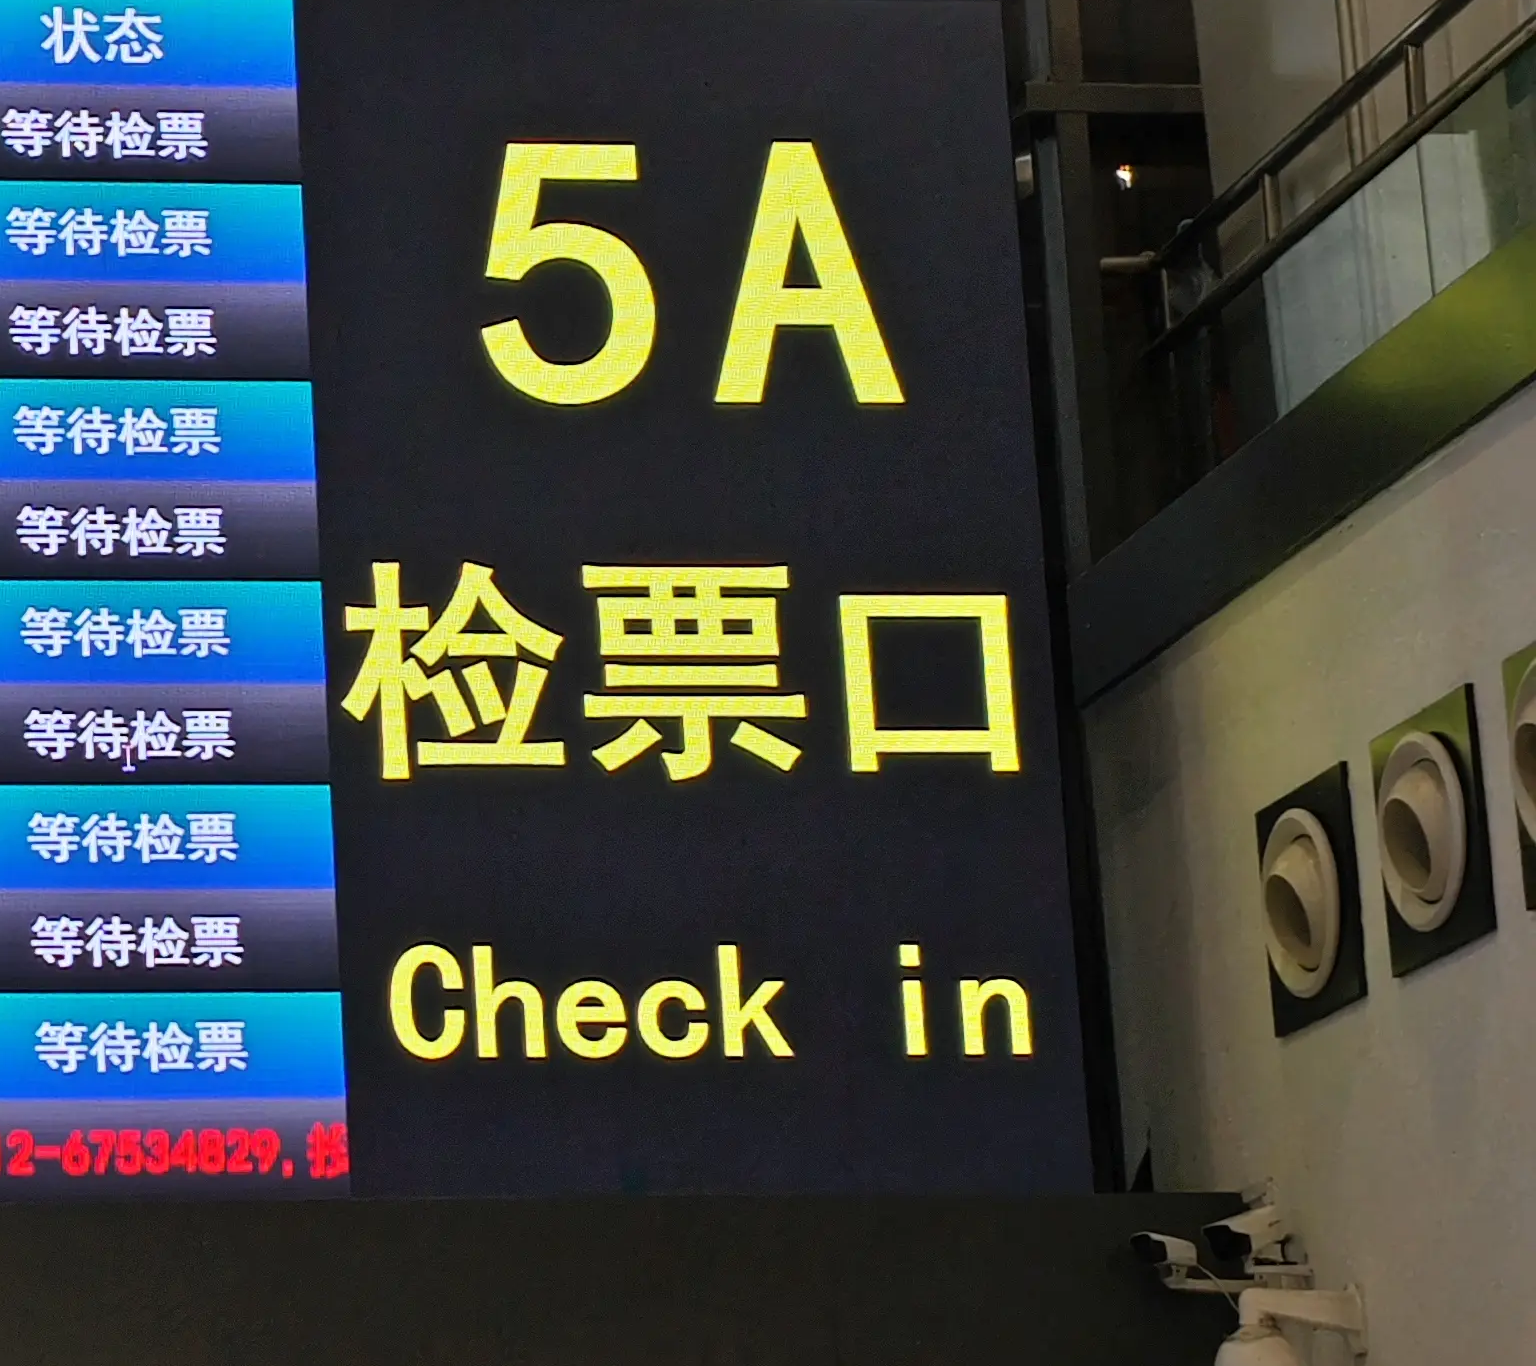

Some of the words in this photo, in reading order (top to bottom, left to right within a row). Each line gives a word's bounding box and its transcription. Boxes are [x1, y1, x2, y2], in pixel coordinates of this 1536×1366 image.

[40, 5, 165, 65] 状态
[0, 107, 210, 161] 等待检票
[5, 206, 214, 258] 等待检票
[480, 140, 907, 406] 5A
[7, 304, 219, 358] 等待检票
[13, 405, 222, 457] 等待检票
[15, 504, 228, 558] 等待检票
[19, 606, 232, 659] 等待检票
[339, 560, 1022, 782] 检票口
[22, 708, 237, 762] 等待检票
[26, 811, 240, 865] 等待检票
[29, 914, 246, 969] 等待检票
[388, 943, 796, 1061] Check
[898, 943, 1034, 1057] in
[34, 1020, 250, 1074] 等待检票
